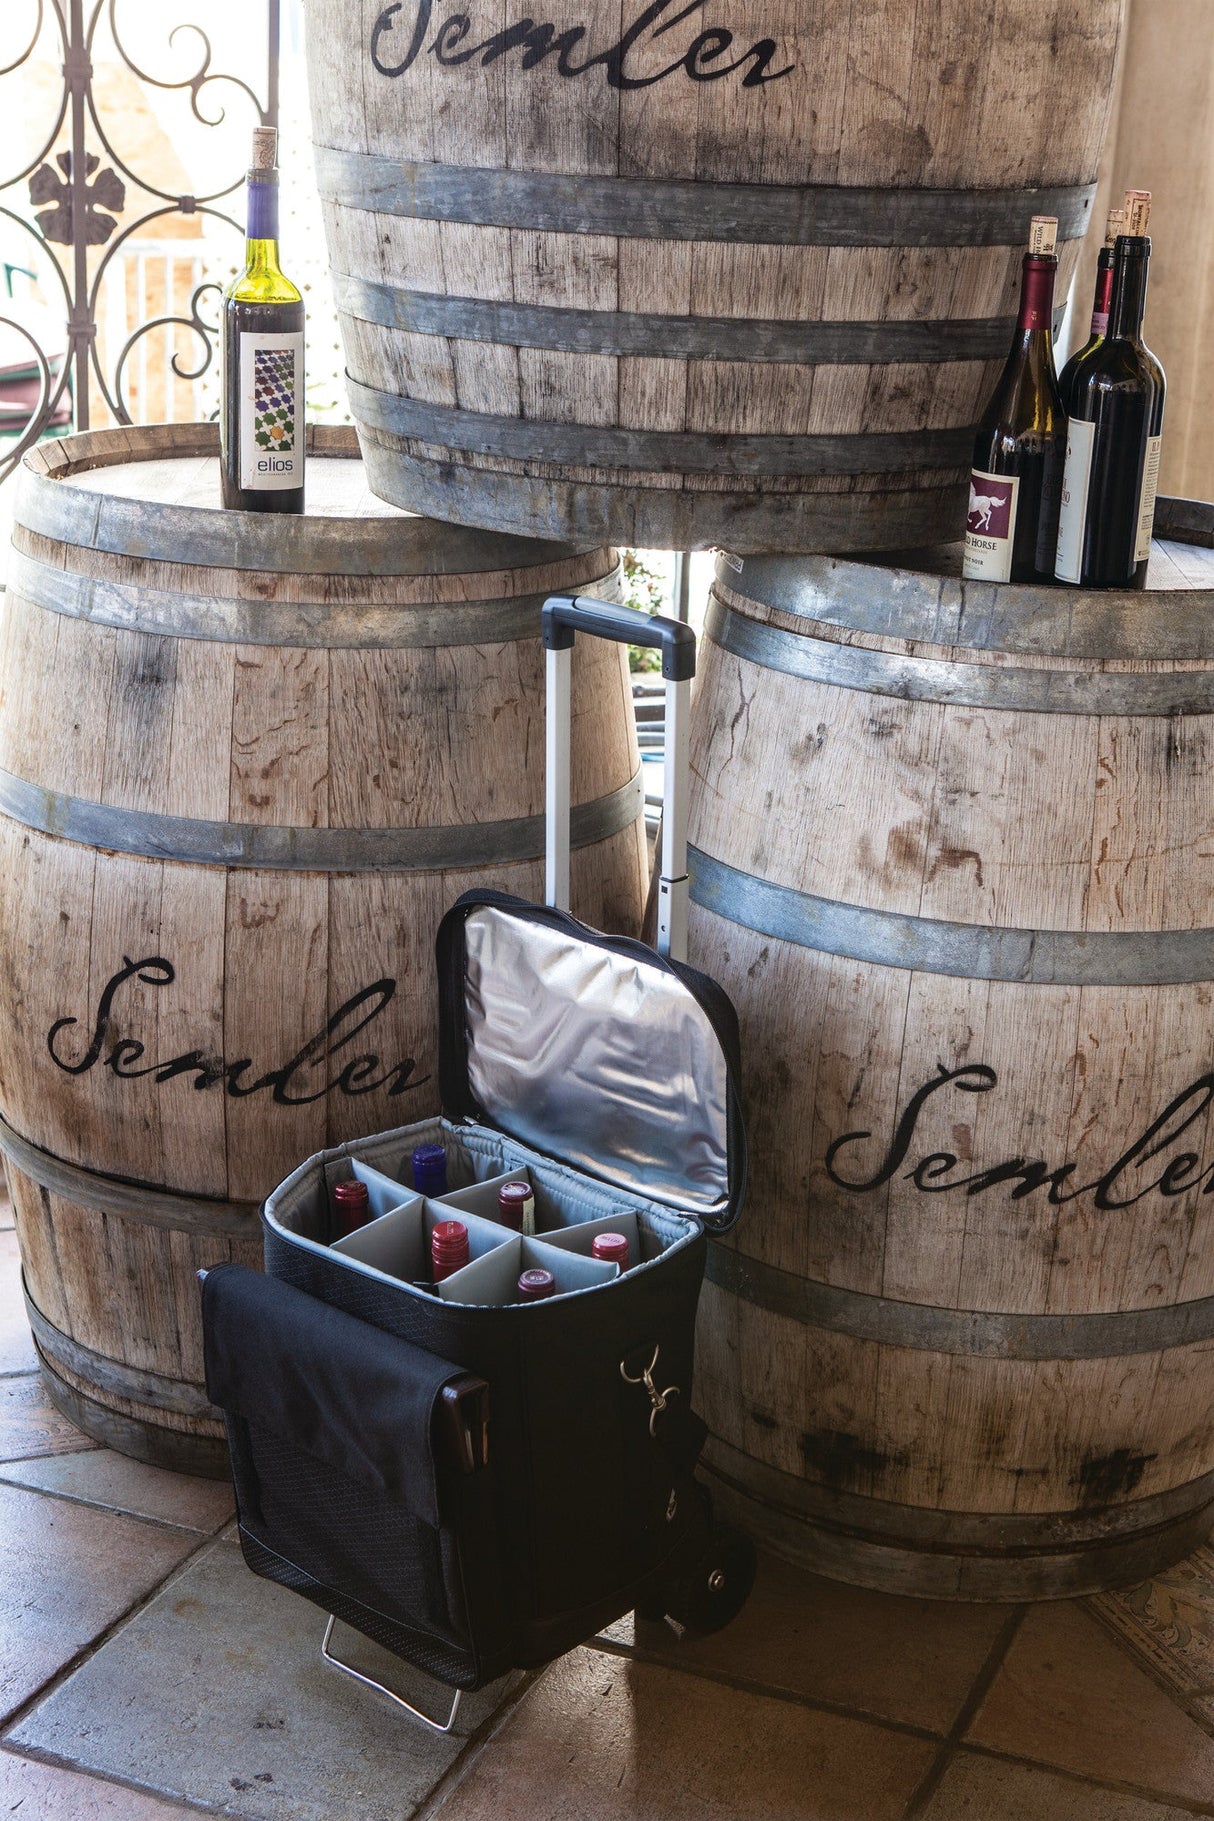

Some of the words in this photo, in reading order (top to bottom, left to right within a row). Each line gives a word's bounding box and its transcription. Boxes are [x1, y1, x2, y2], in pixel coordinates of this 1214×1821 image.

[257, 456, 293, 472] elios
[971, 537, 998, 551] HORSE
[47, 955, 432, 1106] Semler
